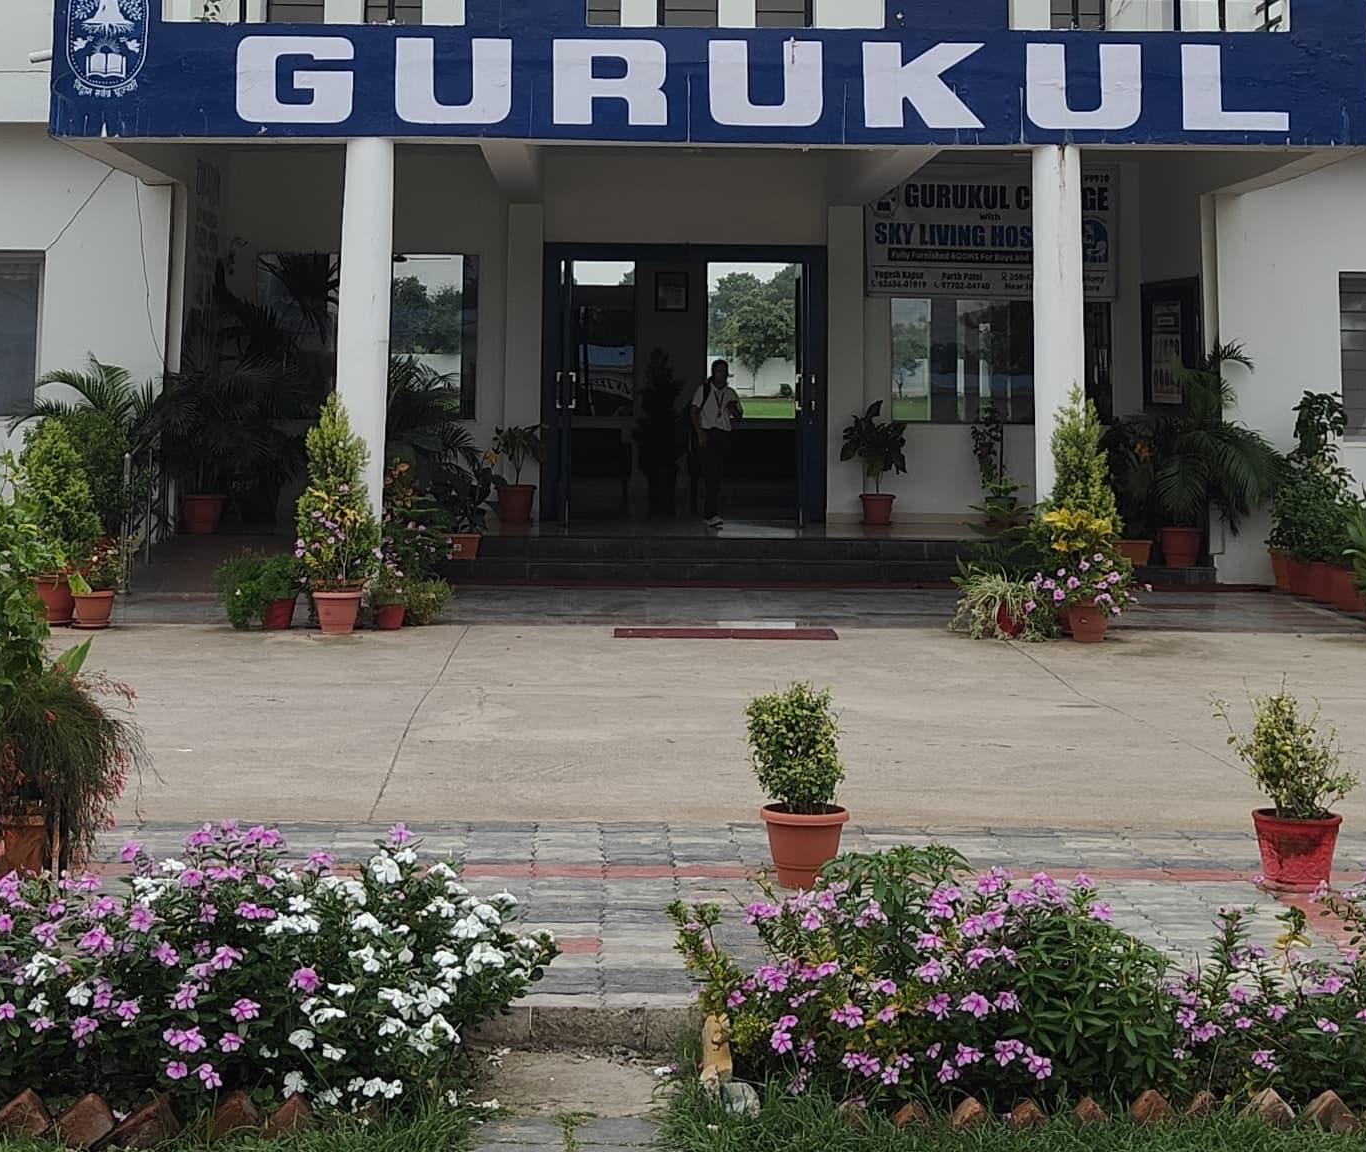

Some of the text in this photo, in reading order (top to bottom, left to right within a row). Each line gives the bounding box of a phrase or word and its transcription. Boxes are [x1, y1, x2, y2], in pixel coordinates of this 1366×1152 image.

[235, 35, 1289, 133] GURUKUL
[1083, 174, 1110, 183] 99910
[905, 183, 1010, 210] GURUKUL
[979, 212, 1001, 221] With
[874, 222, 1033, 248] SKY LIVING HOS
